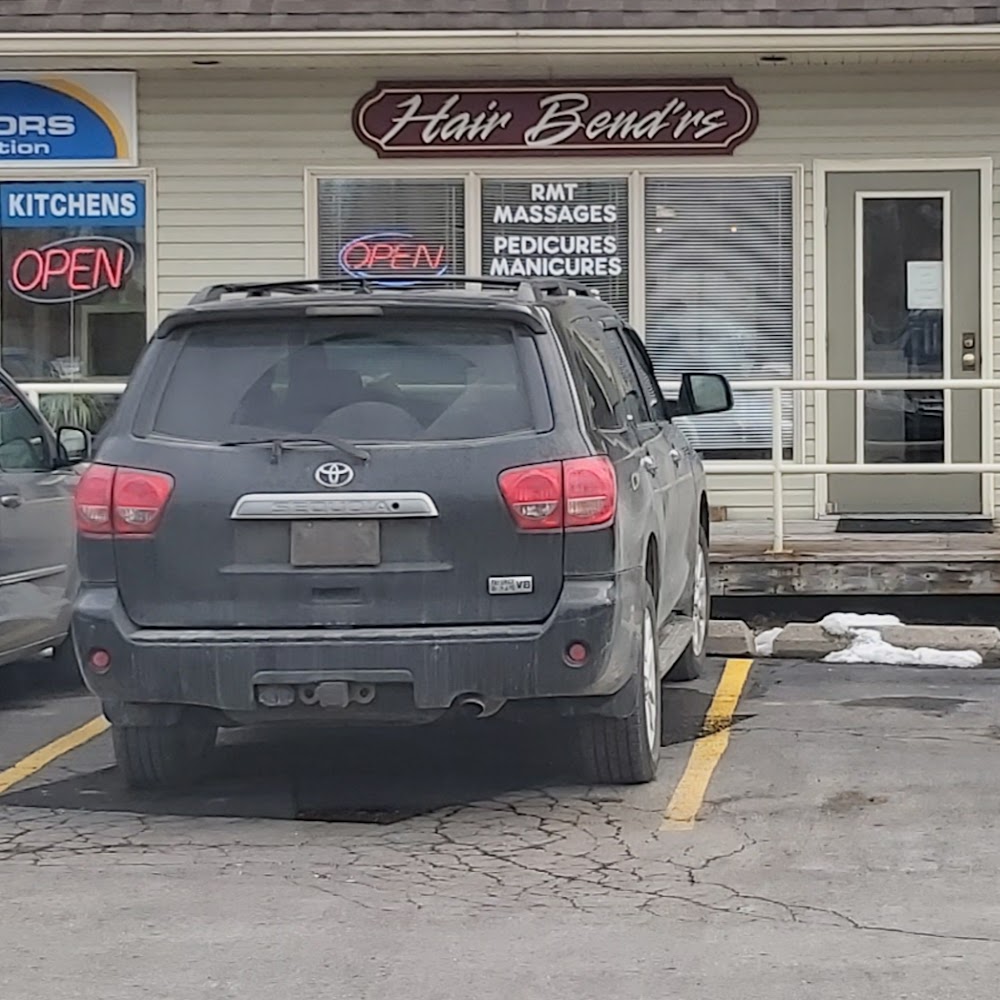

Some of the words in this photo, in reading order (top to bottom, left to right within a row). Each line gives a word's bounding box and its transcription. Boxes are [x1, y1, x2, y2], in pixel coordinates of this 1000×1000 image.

[382, 94, 512, 145] Hair
[524, 93, 728, 147] Bend'rs
[531, 183, 578, 201] RMT
[8, 193, 137, 217] KITCHENS
[493, 204, 618, 223] MASSAGES
[343, 242, 445, 269] OPEN
[494, 235, 618, 255] PEDICURES
[12, 247, 125, 291] OPEN
[490, 257, 622, 276] MANICURES
